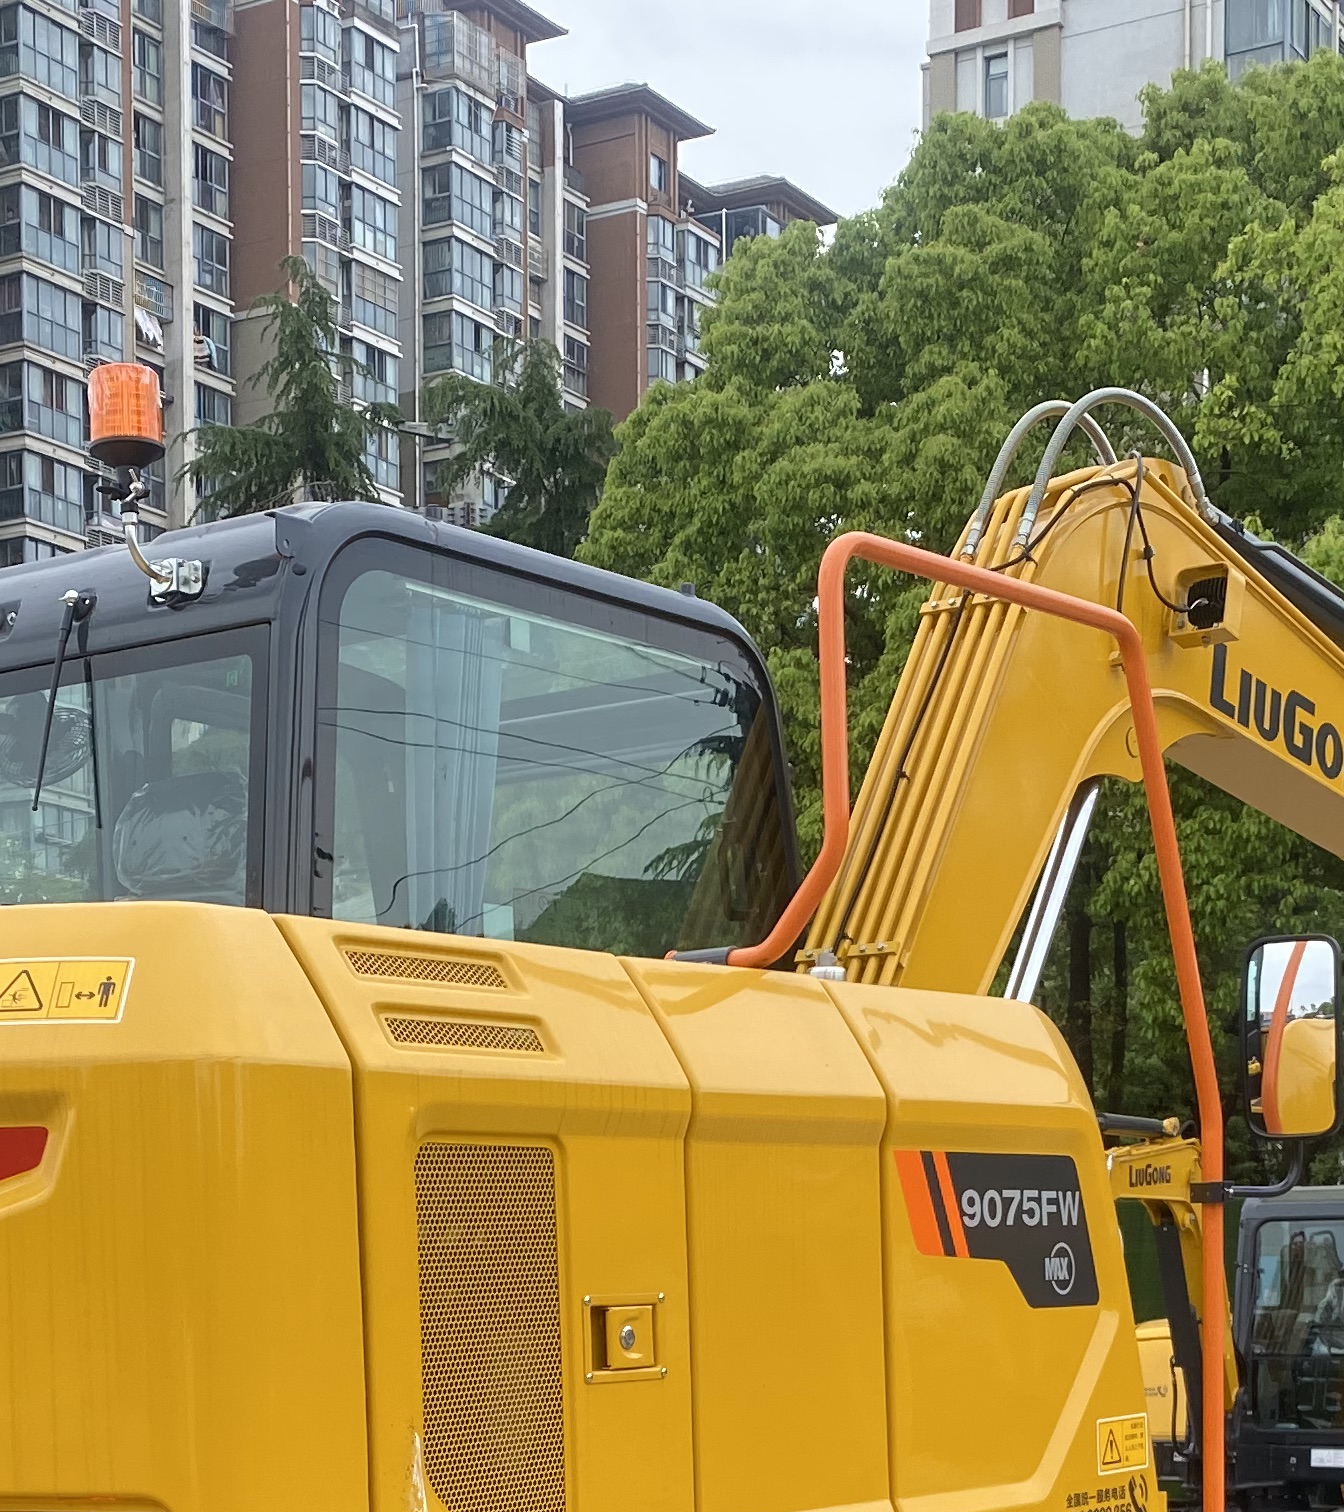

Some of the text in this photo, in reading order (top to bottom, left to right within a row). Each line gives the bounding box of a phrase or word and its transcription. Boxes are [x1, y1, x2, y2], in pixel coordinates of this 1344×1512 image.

[960, 1188, 1080, 1229] 9075FW
[1044, 1257, 1069, 1281] MAX
[1065, 1485, 1126, 1509] 全国统一服务电话
